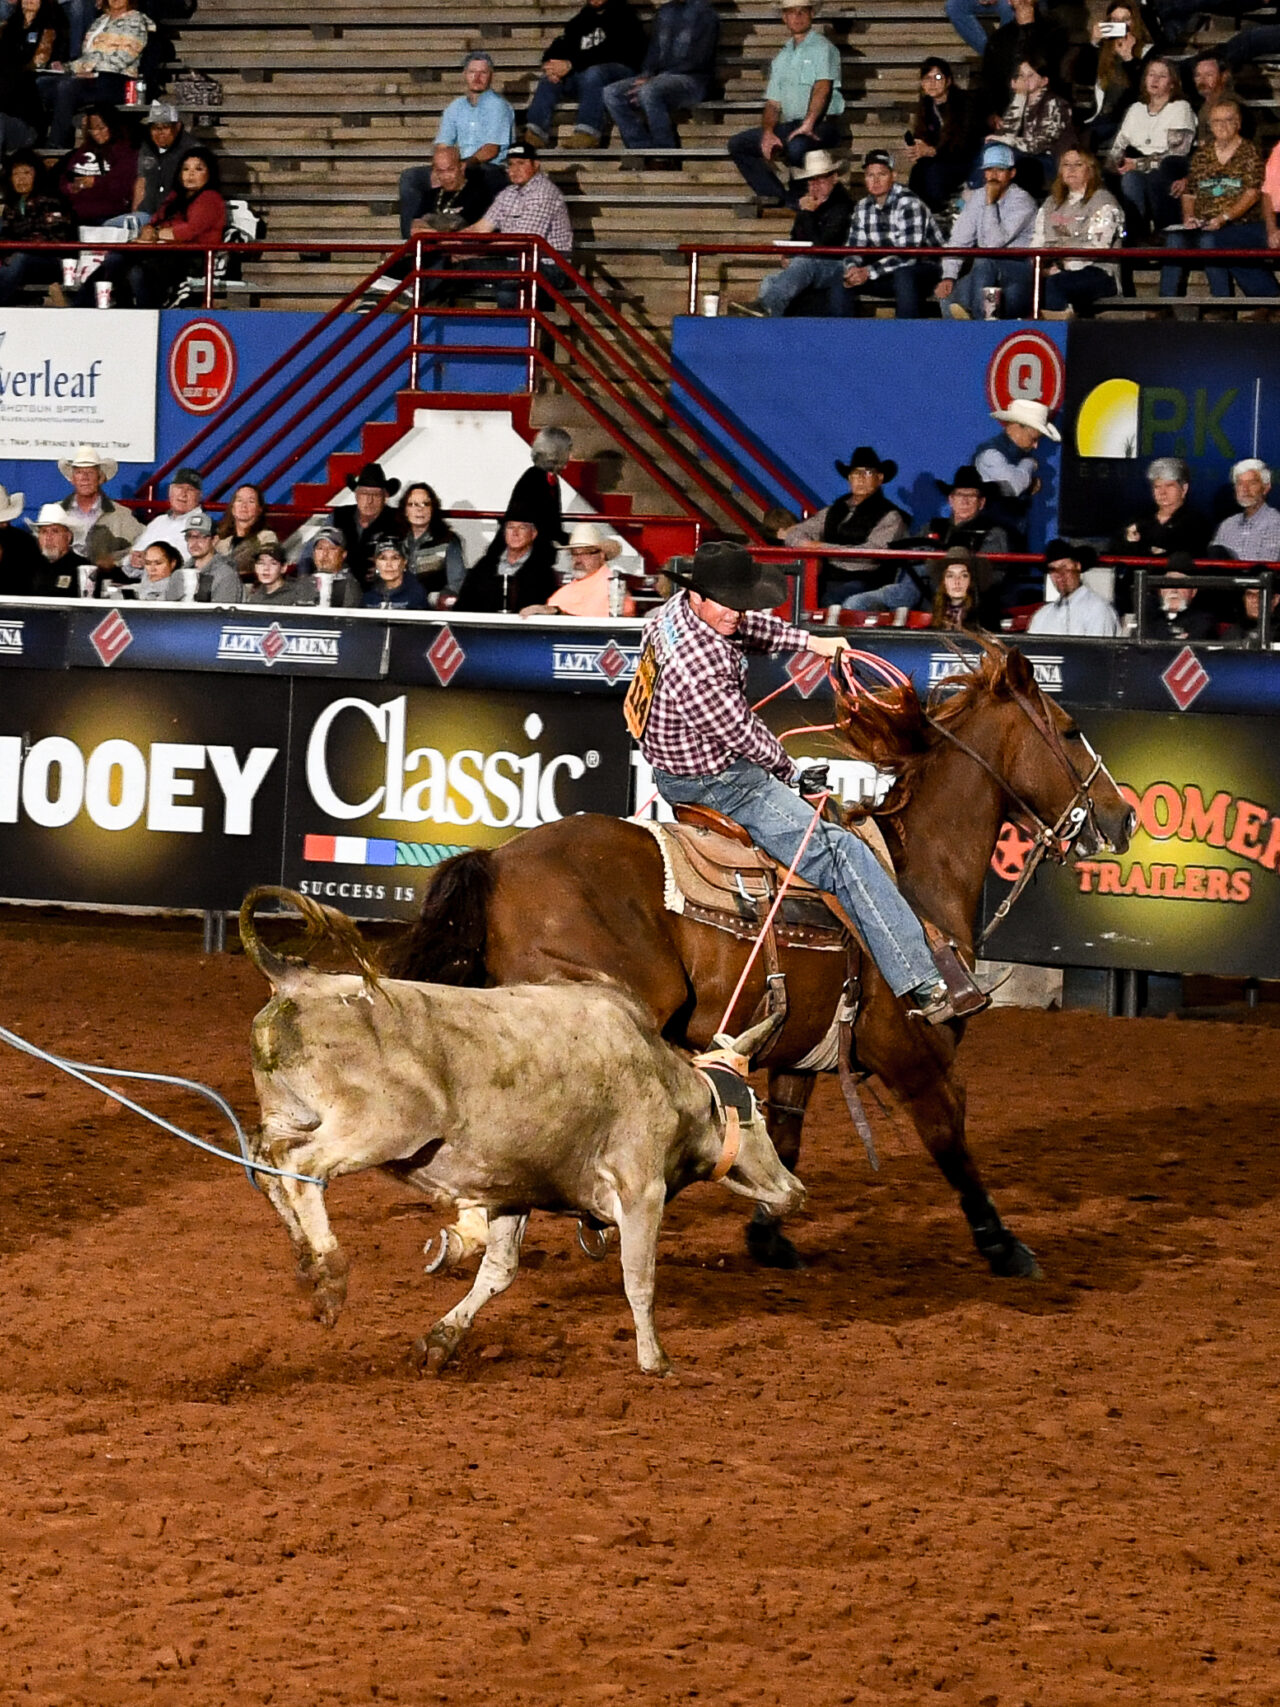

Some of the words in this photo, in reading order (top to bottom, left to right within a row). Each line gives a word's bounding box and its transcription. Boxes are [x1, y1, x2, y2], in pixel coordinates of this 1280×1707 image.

[187, 340, 215, 384] P
[1008, 353, 1043, 400] Q
[56, 405, 98, 414] SPORTS
[218, 634, 261, 652] LAZY
[287, 637, 339, 655] ARENA
[553, 652, 595, 671] LAZY
[1118, 780, 1280, 872] OME
[299, 880, 386, 900] SUCCESS
[394, 886, 415, 901] IS
[1074, 861, 1252, 902] TRAILERS
